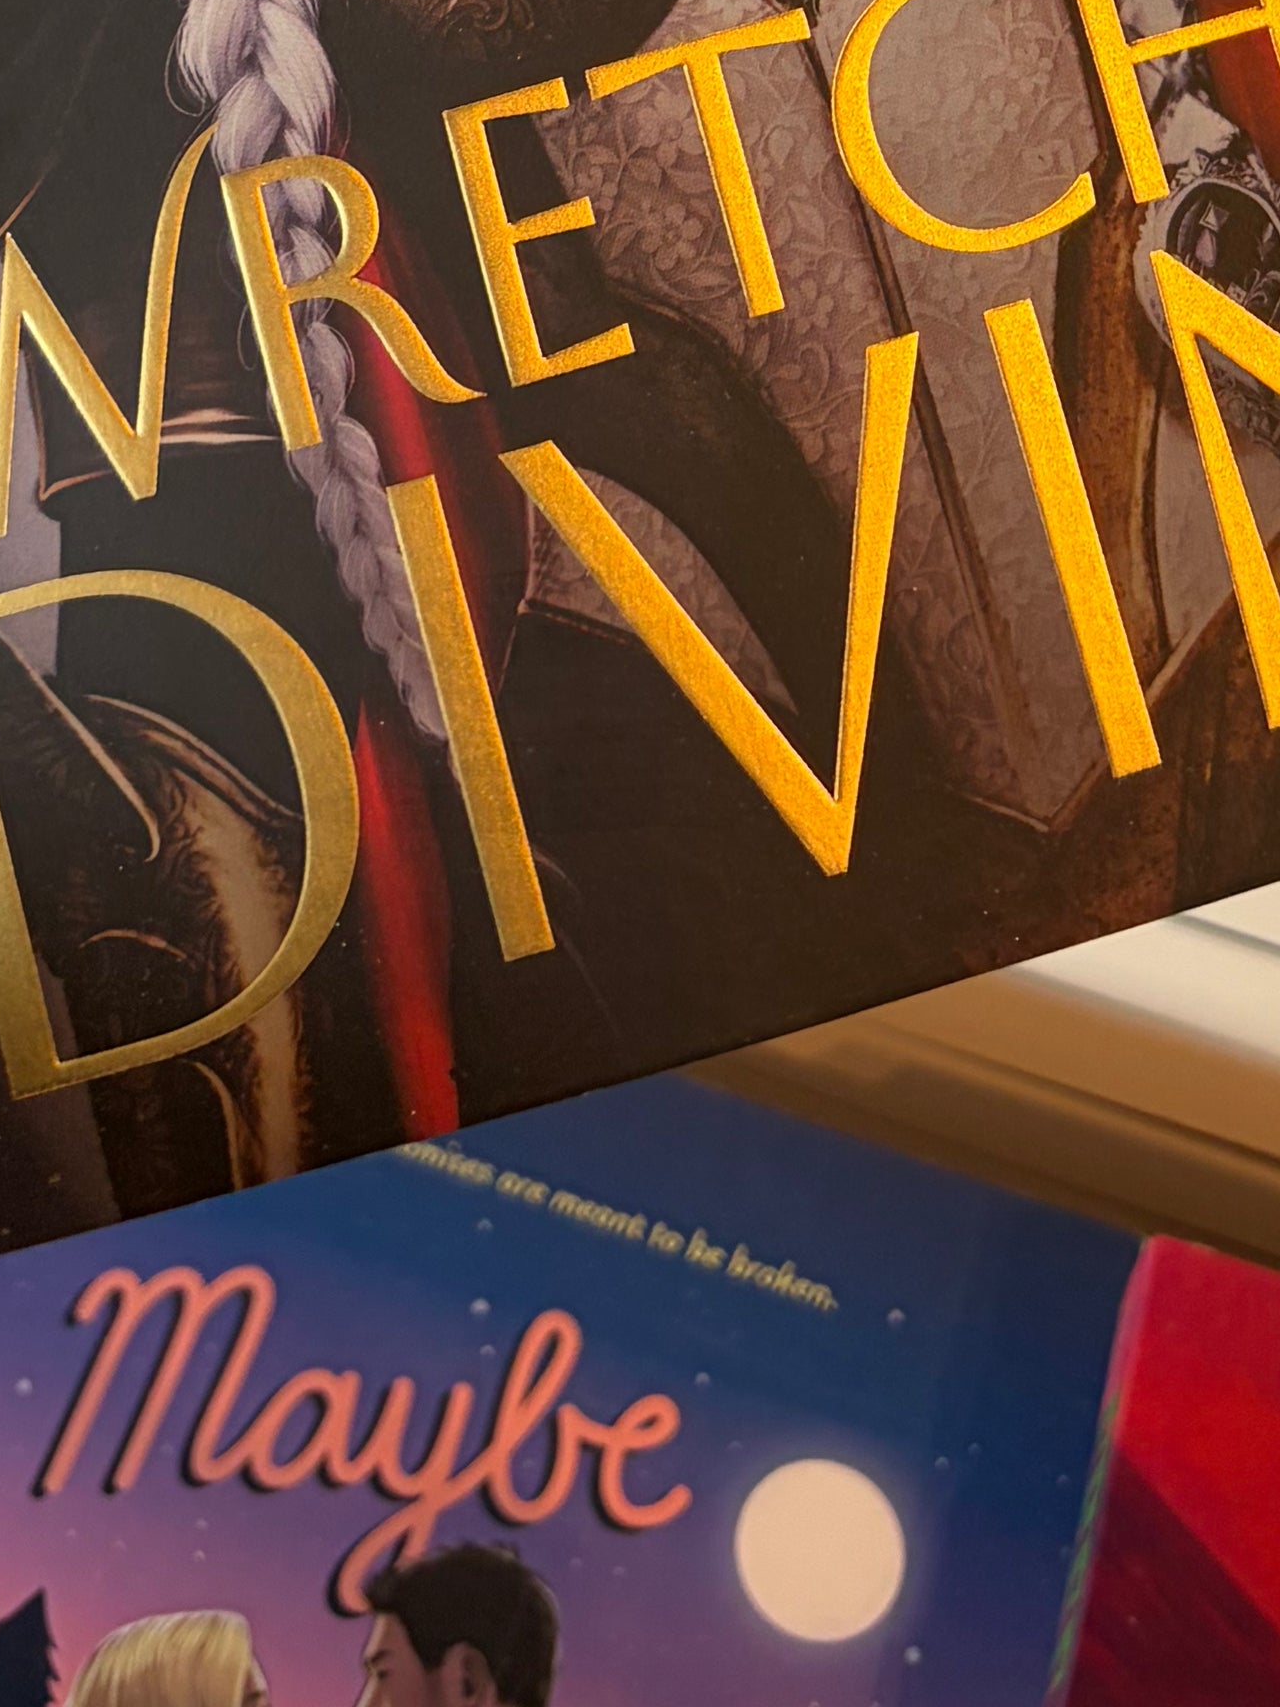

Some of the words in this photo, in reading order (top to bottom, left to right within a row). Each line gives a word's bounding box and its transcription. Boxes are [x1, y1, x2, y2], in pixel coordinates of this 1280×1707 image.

[494, 1170, 551, 1206] are
[549, 1188, 649, 1241] meant
[646, 1220, 686, 1254] to
[683, 1226, 728, 1270] be
[725, 1243, 840, 1312] broken.
[33, 1263, 692, 1619] Maybe
